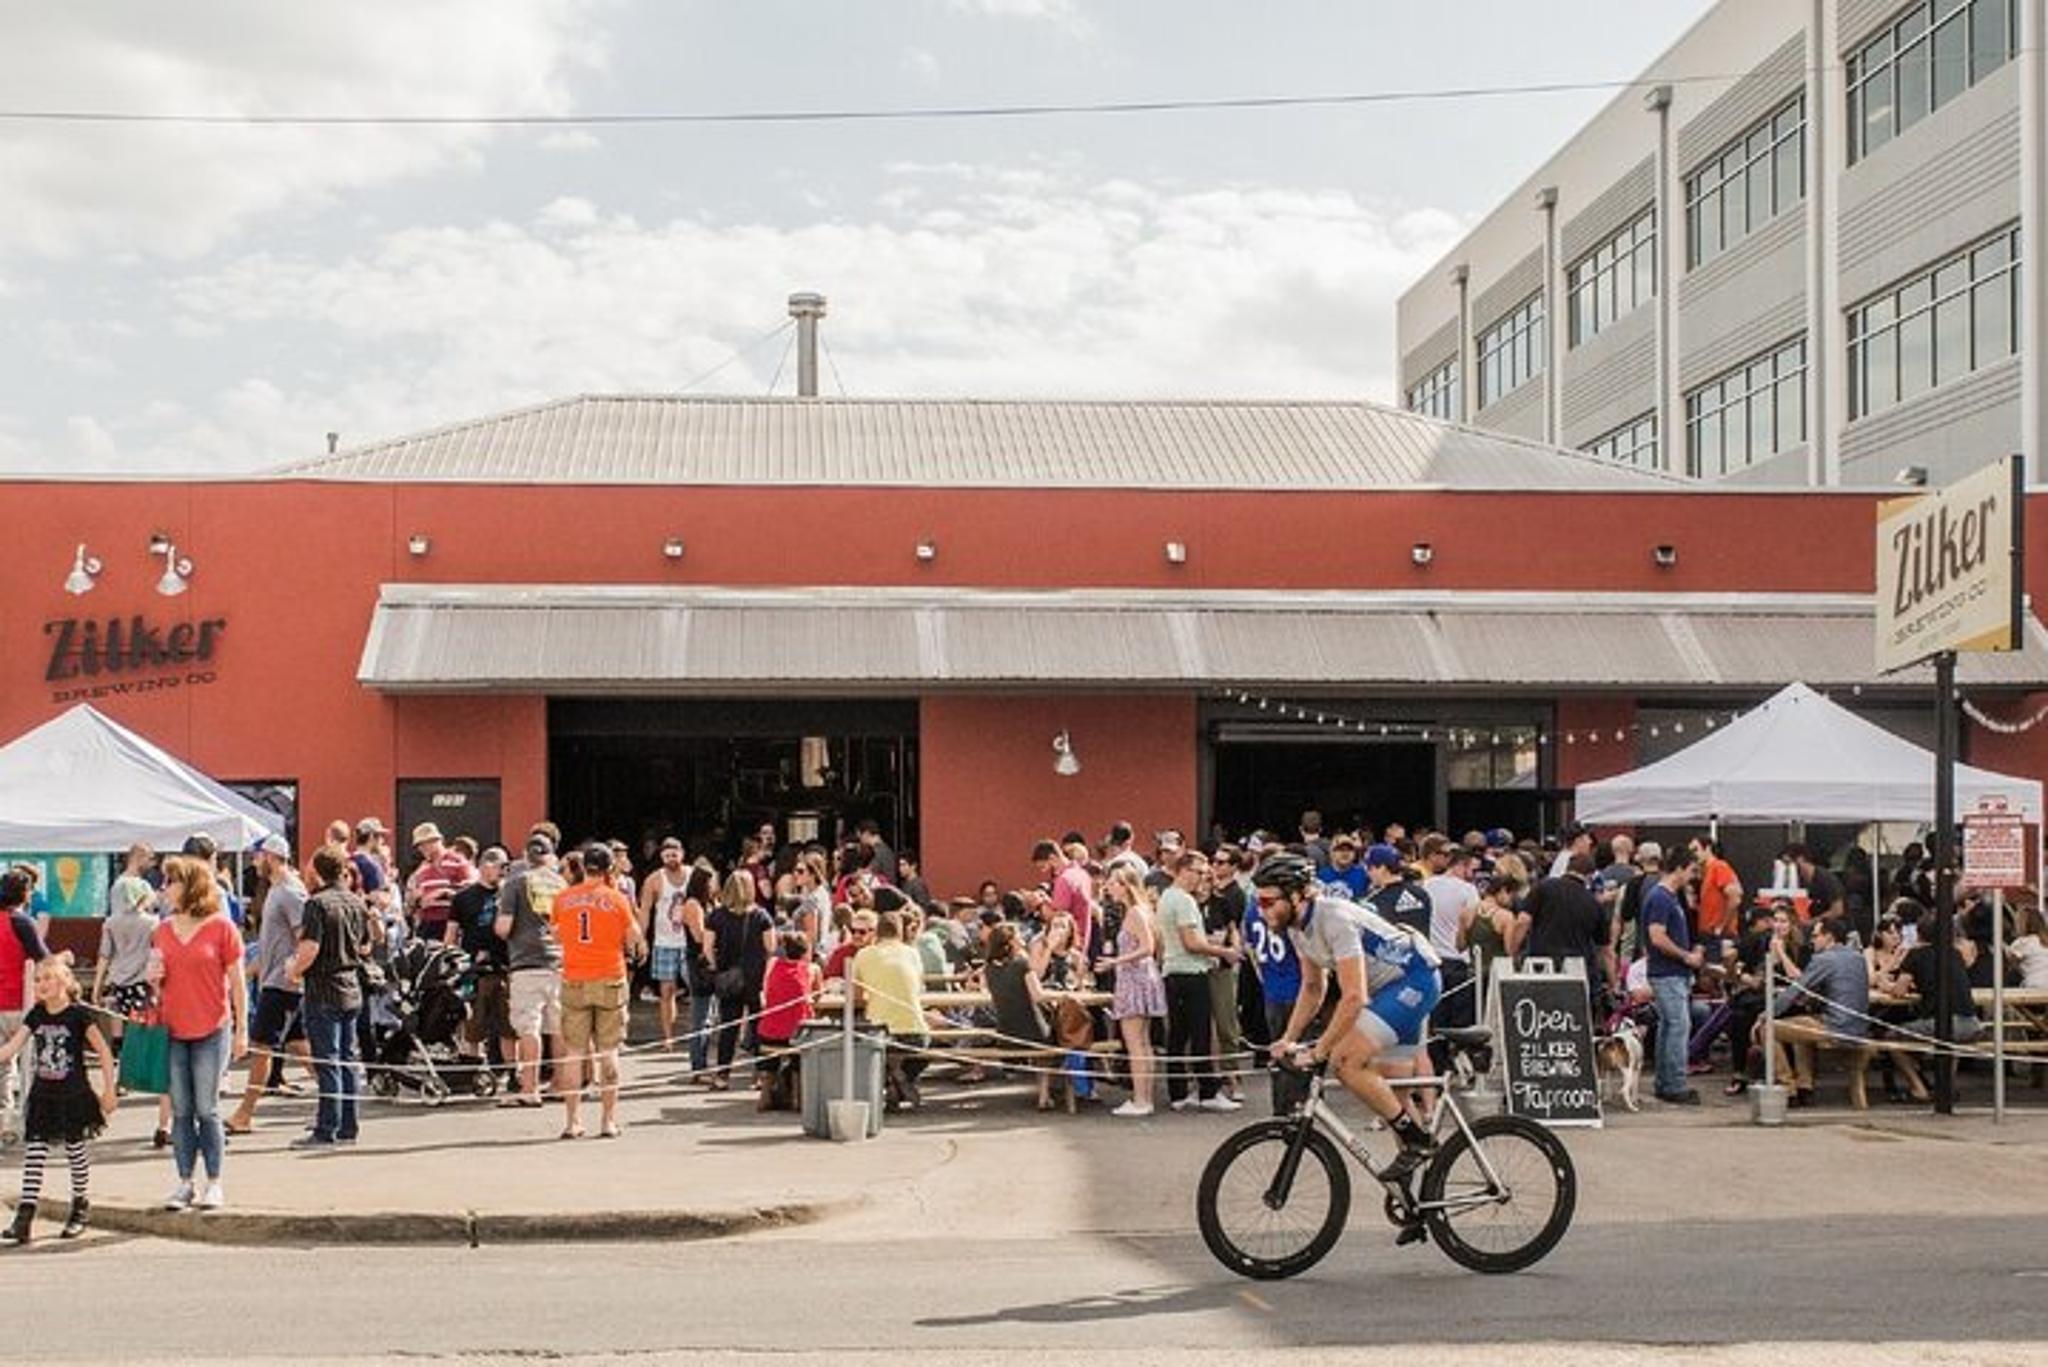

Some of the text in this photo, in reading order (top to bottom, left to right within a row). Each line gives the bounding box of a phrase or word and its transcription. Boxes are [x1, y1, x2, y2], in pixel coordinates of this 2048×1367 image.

[1893, 494, 1996, 618] Zilker
[43, 614, 227, 681] Zilker
[578, 910, 593, 943] 1
[1513, 998, 1582, 1040] Open
[1520, 1042, 1579, 1058] ZILKER
[1512, 1081, 1598, 1118] Taproom
